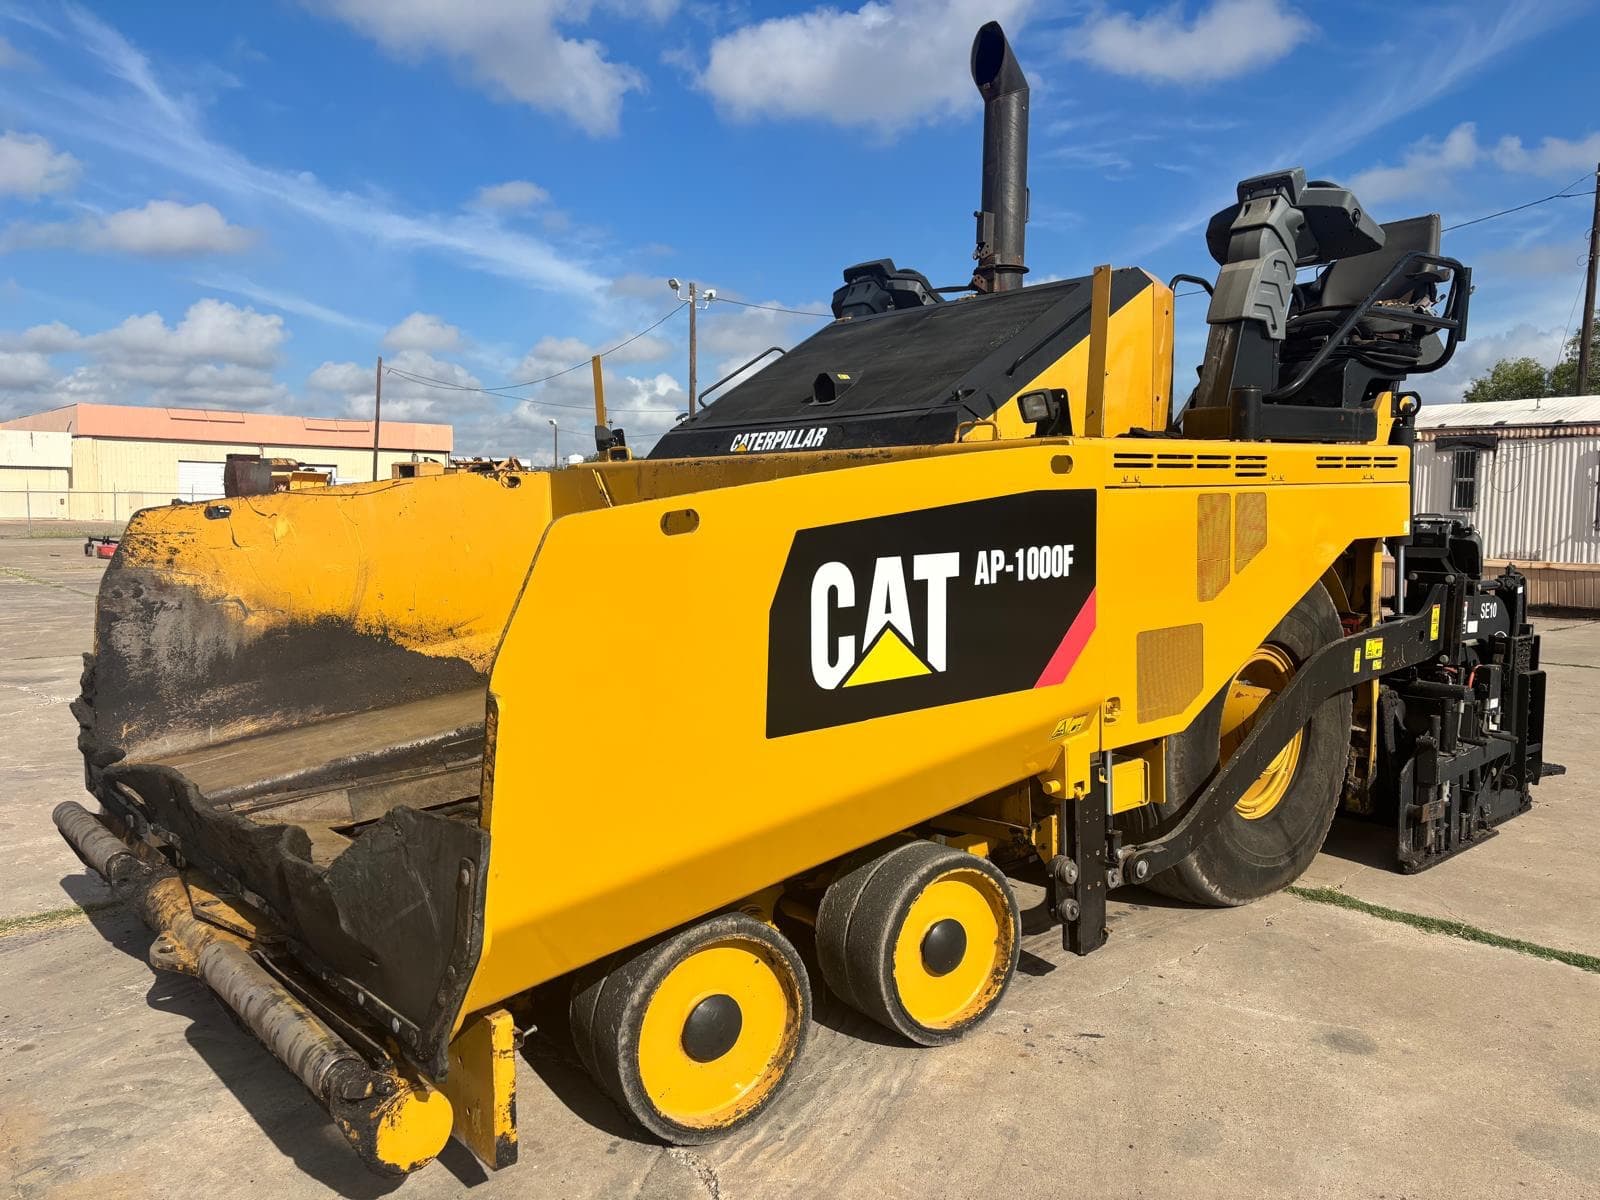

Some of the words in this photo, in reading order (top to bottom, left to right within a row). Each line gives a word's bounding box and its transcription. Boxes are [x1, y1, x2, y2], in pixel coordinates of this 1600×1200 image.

[730, 427, 828, 452] CATERPILLAR
[810, 551, 960, 690] CAT
[974, 544, 1074, 585] AP-1000F
[1480, 602, 1497, 618] SE10
